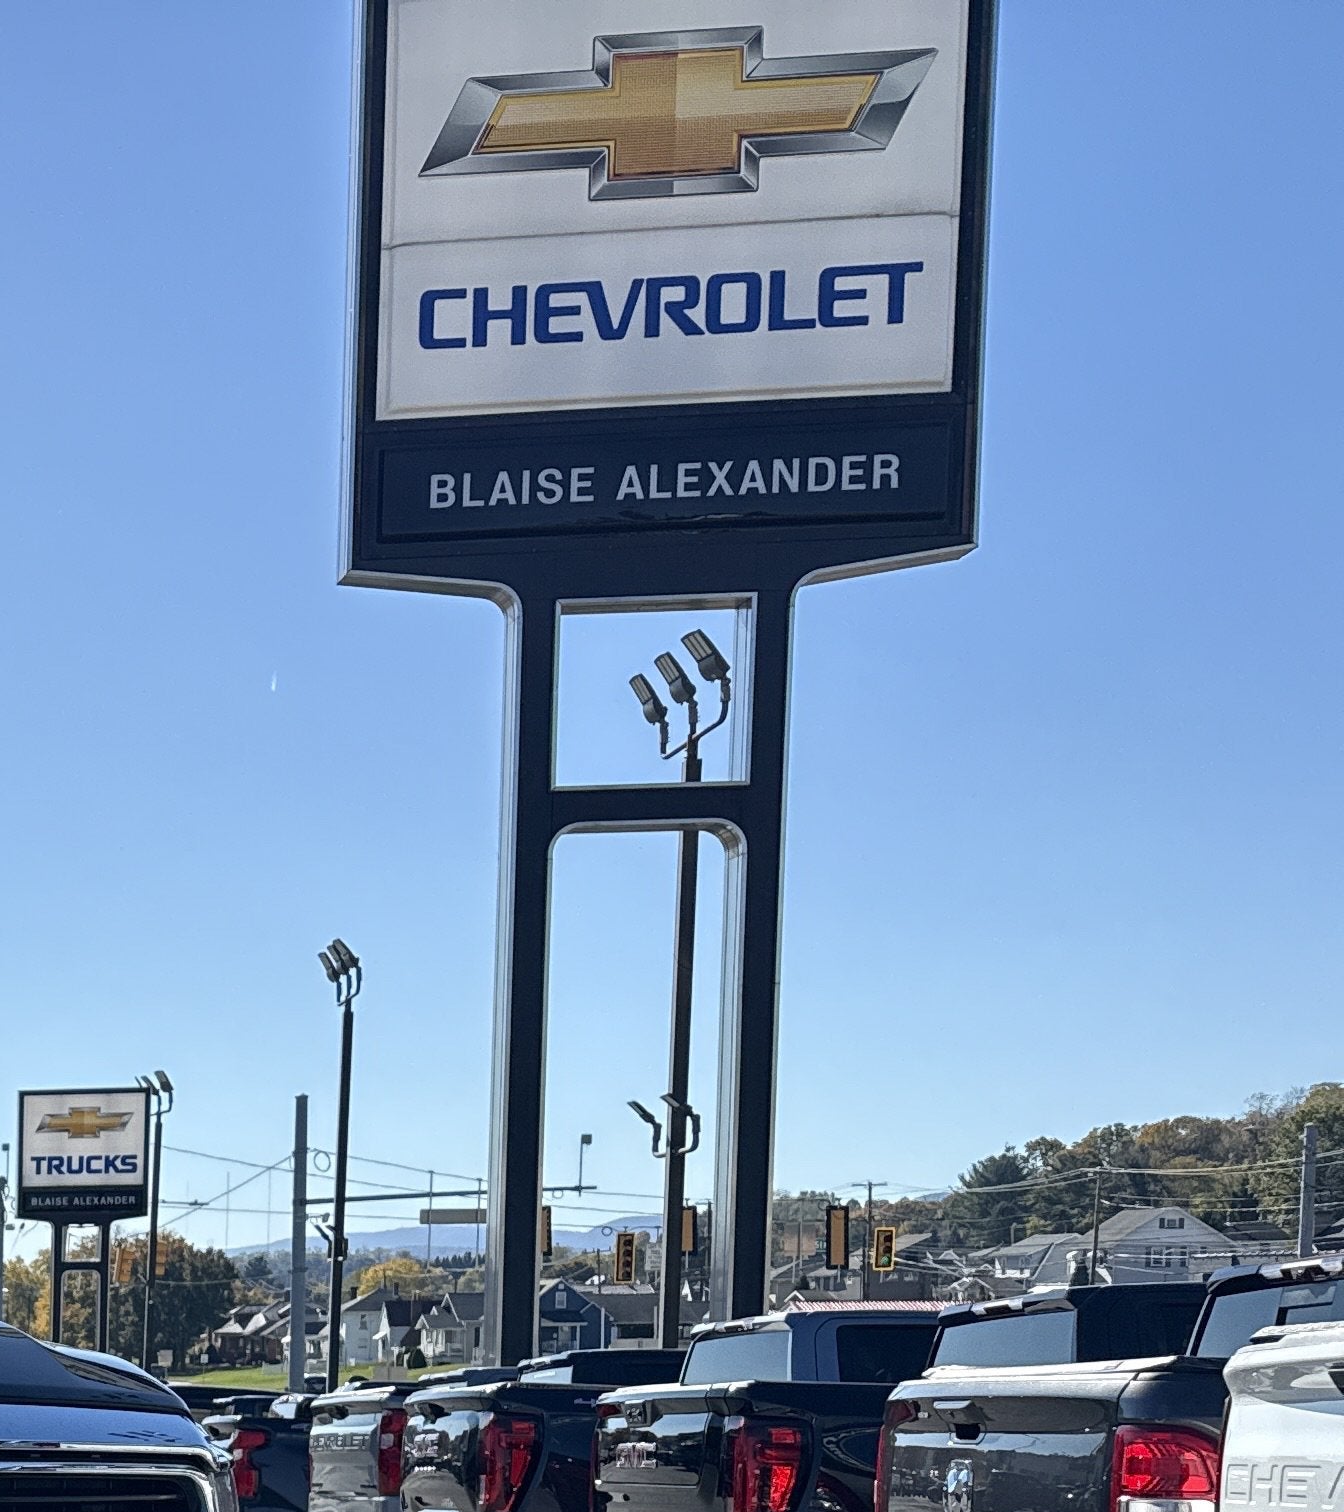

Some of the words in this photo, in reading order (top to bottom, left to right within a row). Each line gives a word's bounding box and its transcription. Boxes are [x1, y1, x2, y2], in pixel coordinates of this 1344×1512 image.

[418, 261, 924, 350] CHEVROLET
[428, 465, 595, 510] BLAISE
[616, 452, 901, 502] ALEXANDER
[30, 1154, 138, 1175] TRUCKS
[31, 1196, 69, 1207] BLAISE
[73, 1195, 136, 1206] ALEXANDER
